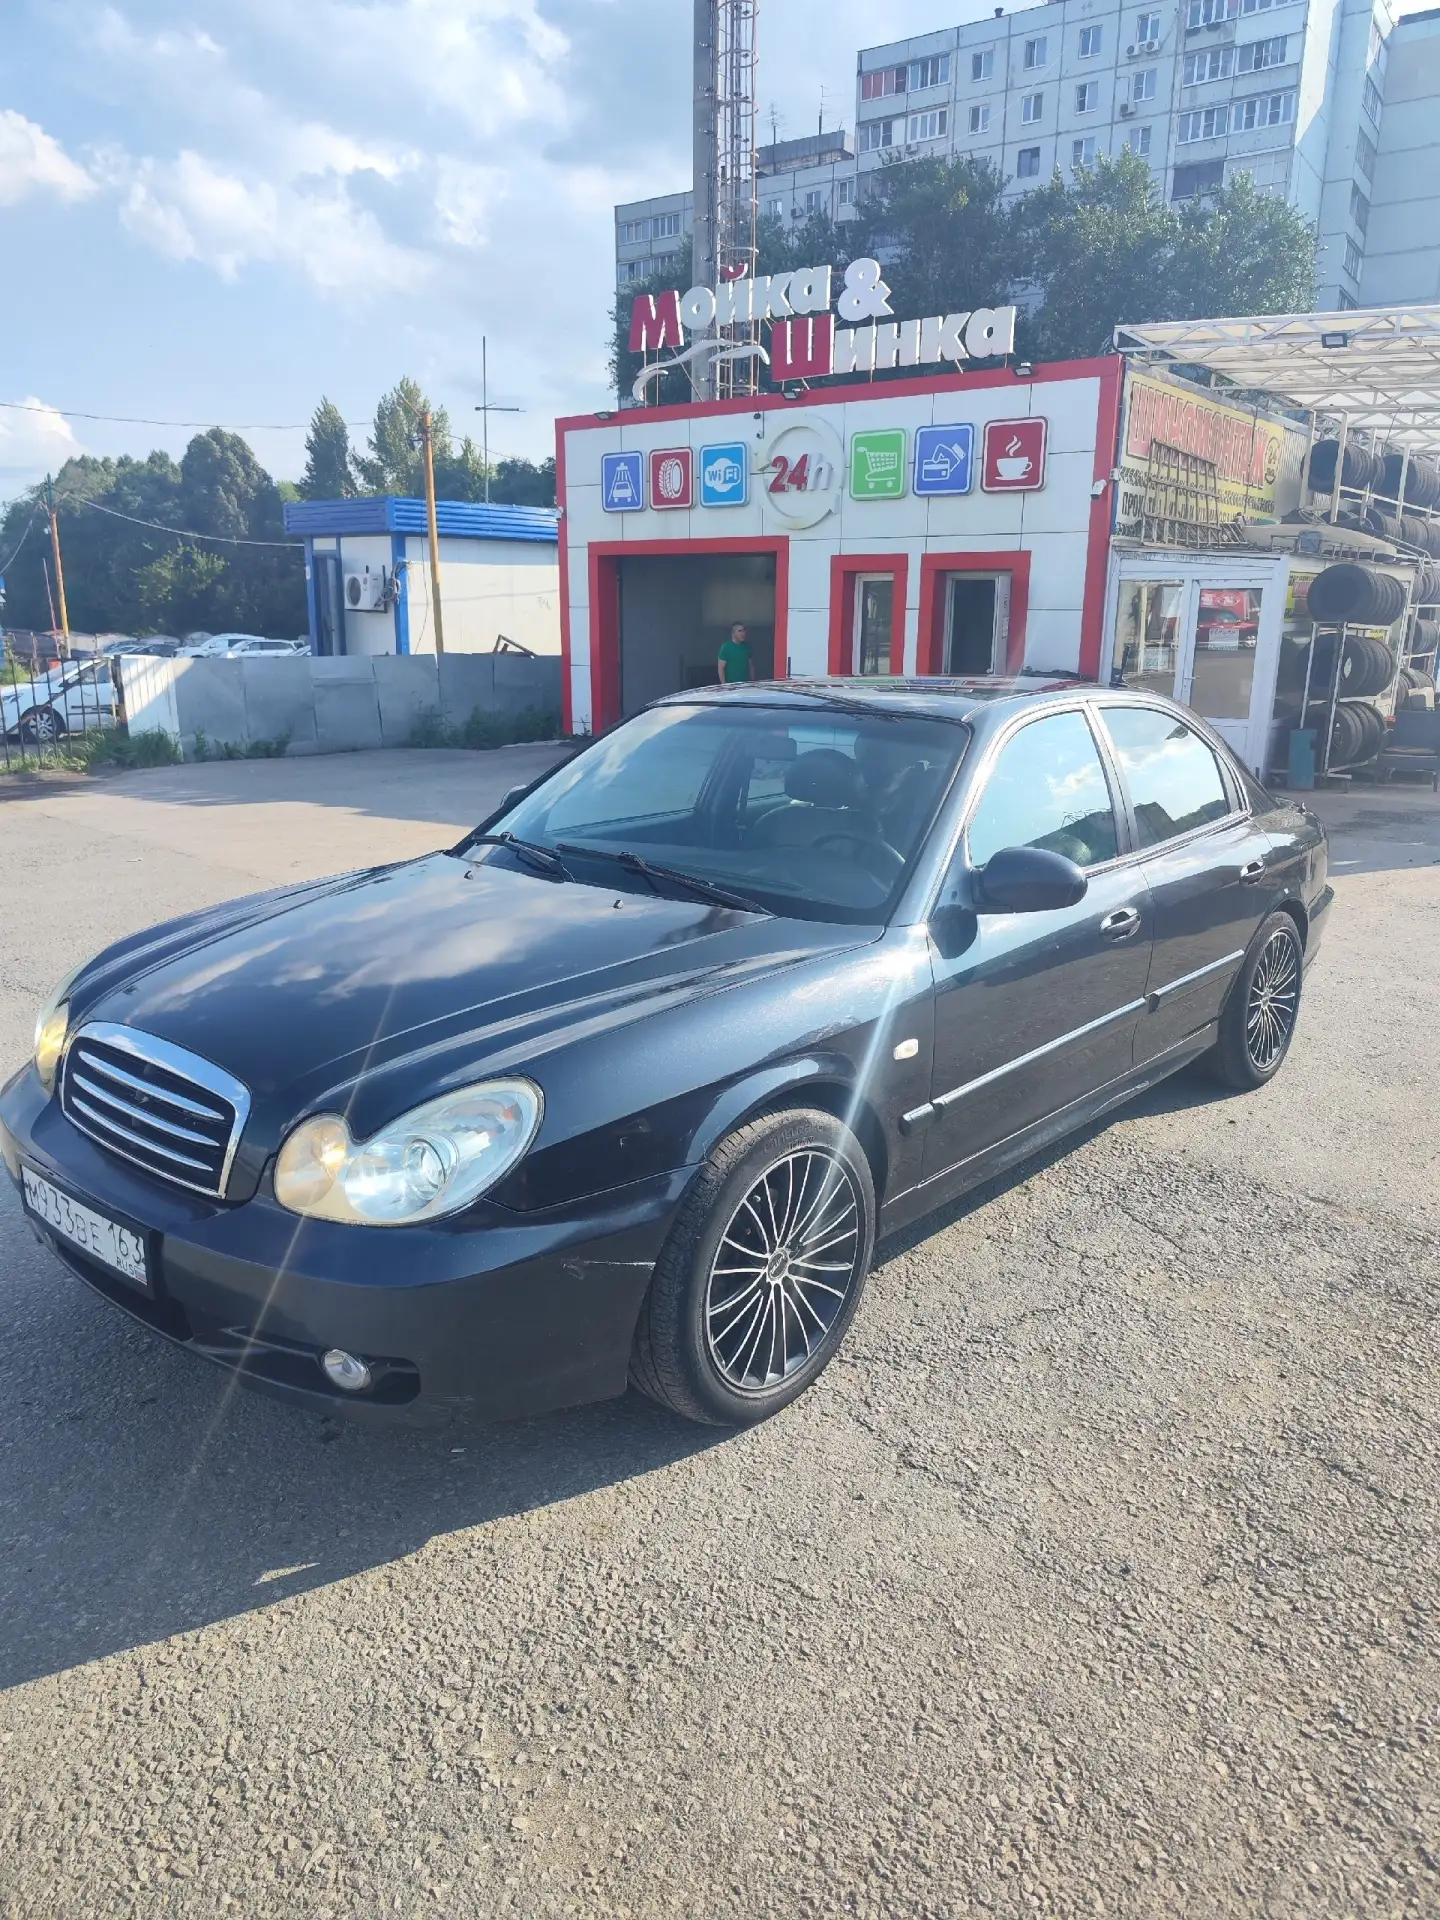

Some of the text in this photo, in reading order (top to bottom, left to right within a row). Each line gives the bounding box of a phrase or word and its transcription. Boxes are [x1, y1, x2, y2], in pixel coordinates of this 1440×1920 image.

[628, 257, 893, 352] Мойка &
[771, 305, 1016, 381] Шинка
[768, 453, 834, 493] 24h
[107, 1222, 143, 1265] 163
[116, 1256, 136, 1276] RUS
